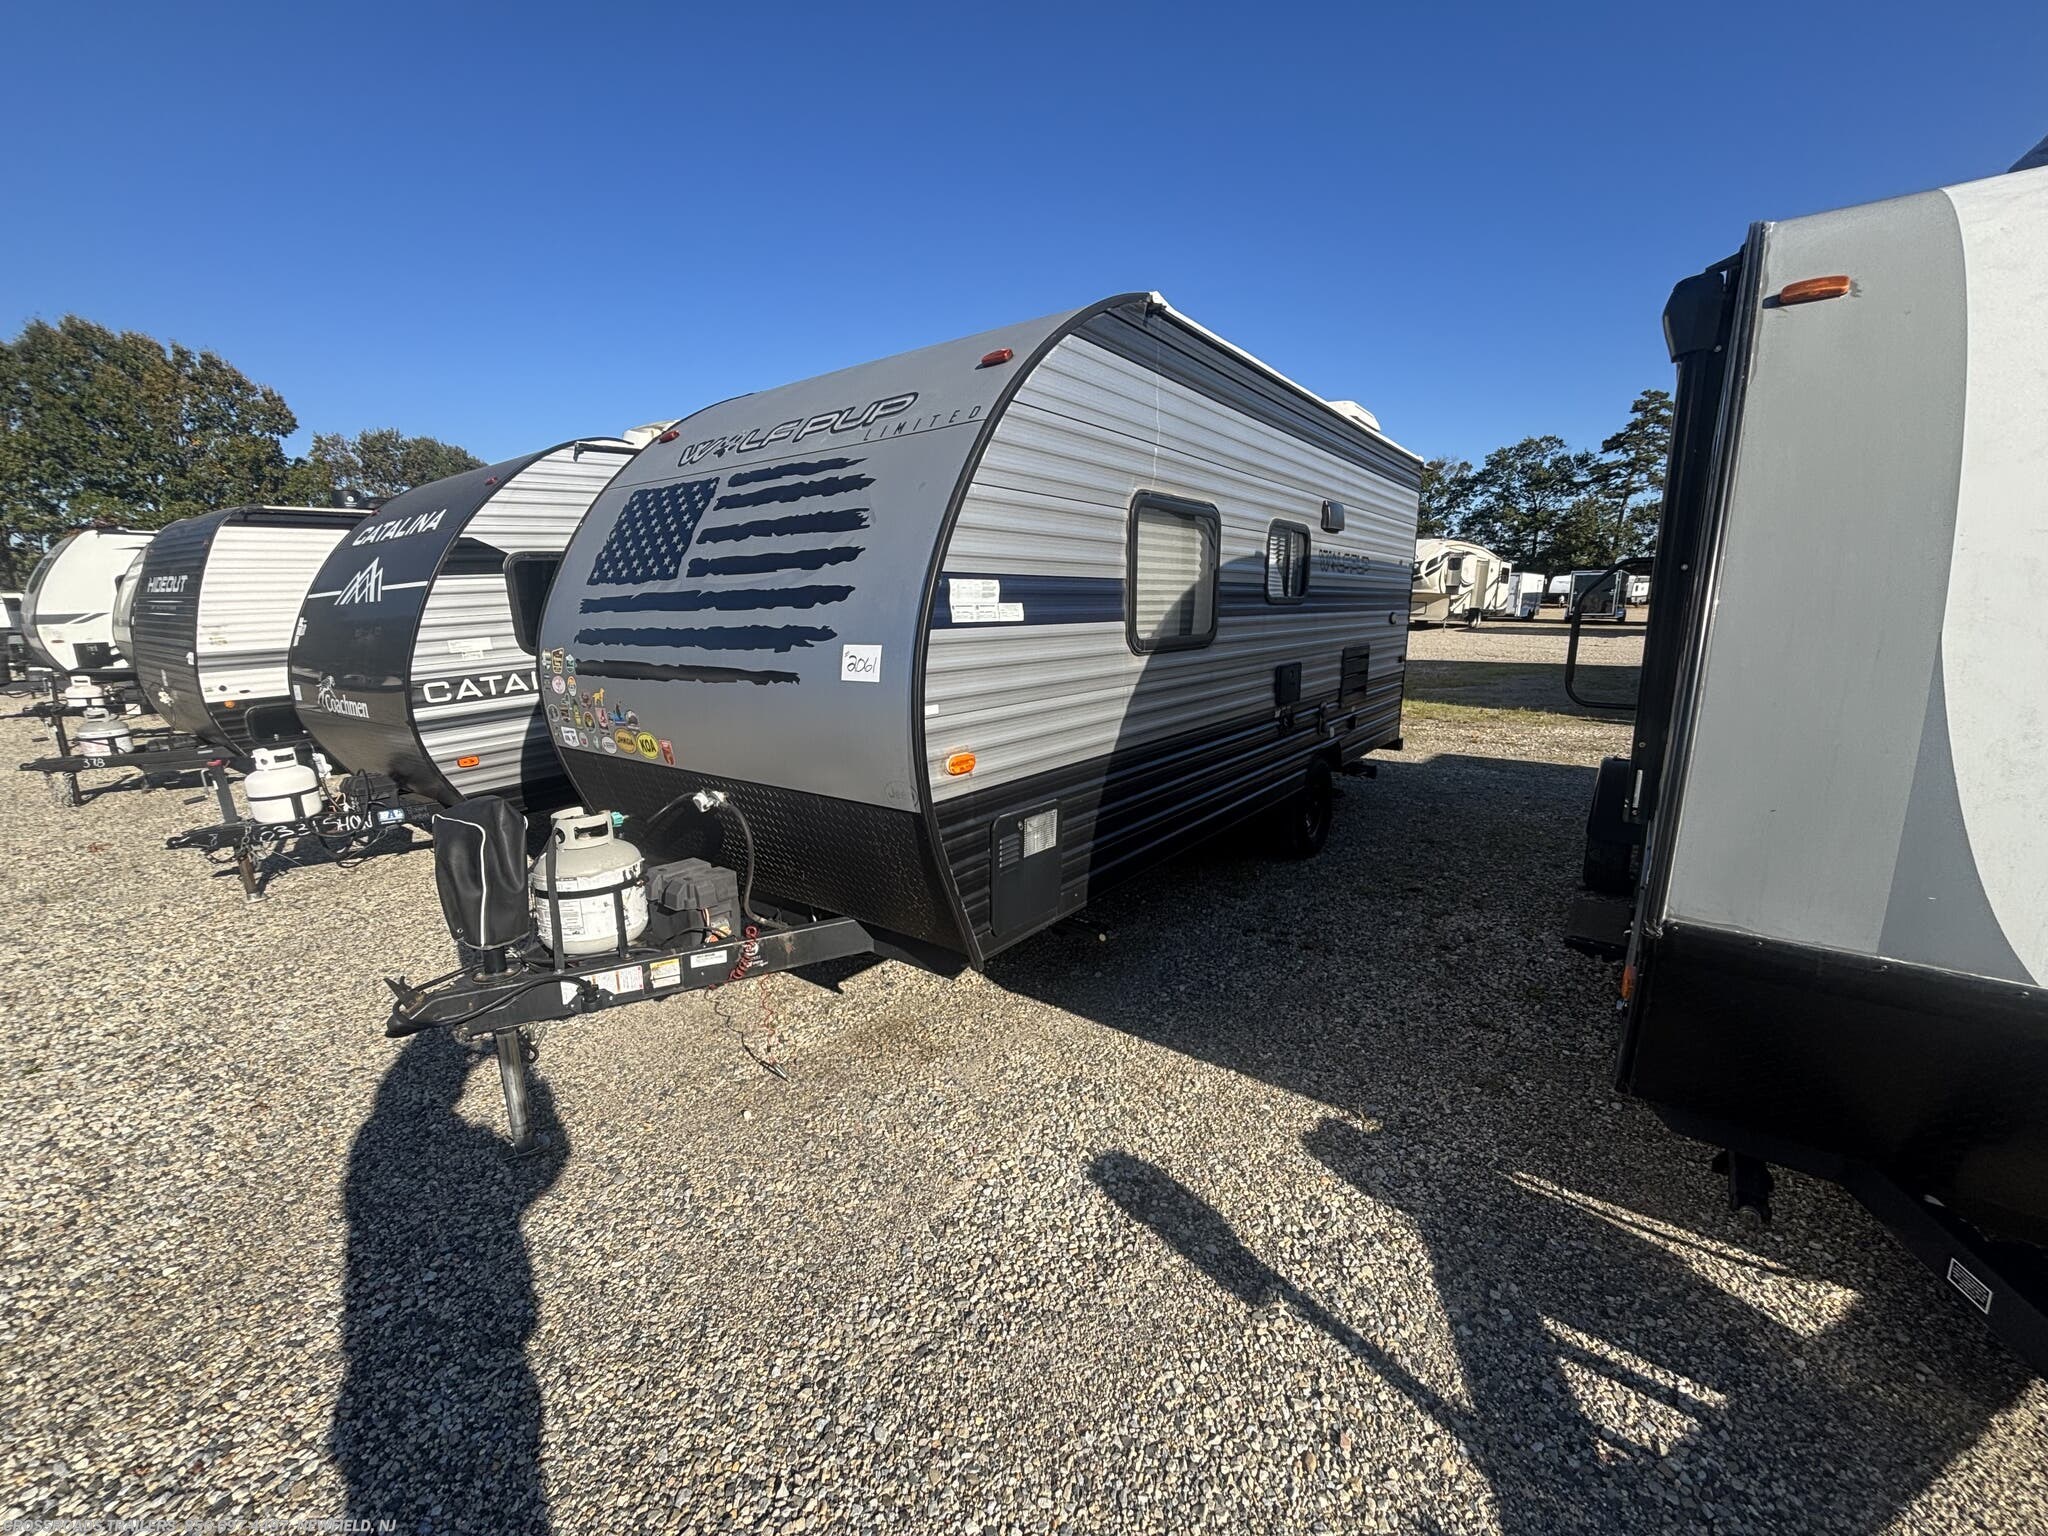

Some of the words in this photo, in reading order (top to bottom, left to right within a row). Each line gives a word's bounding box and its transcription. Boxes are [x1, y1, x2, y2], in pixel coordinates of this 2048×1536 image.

[863, 405, 982, 441] LIMITED
[352, 508, 447, 547] CATALINA
[147, 575, 188, 592] HIDEOUT
[325, 694, 370, 718] Coachmen
[639, 738, 657, 753] KOA
[81, 757, 106, 768] 378
